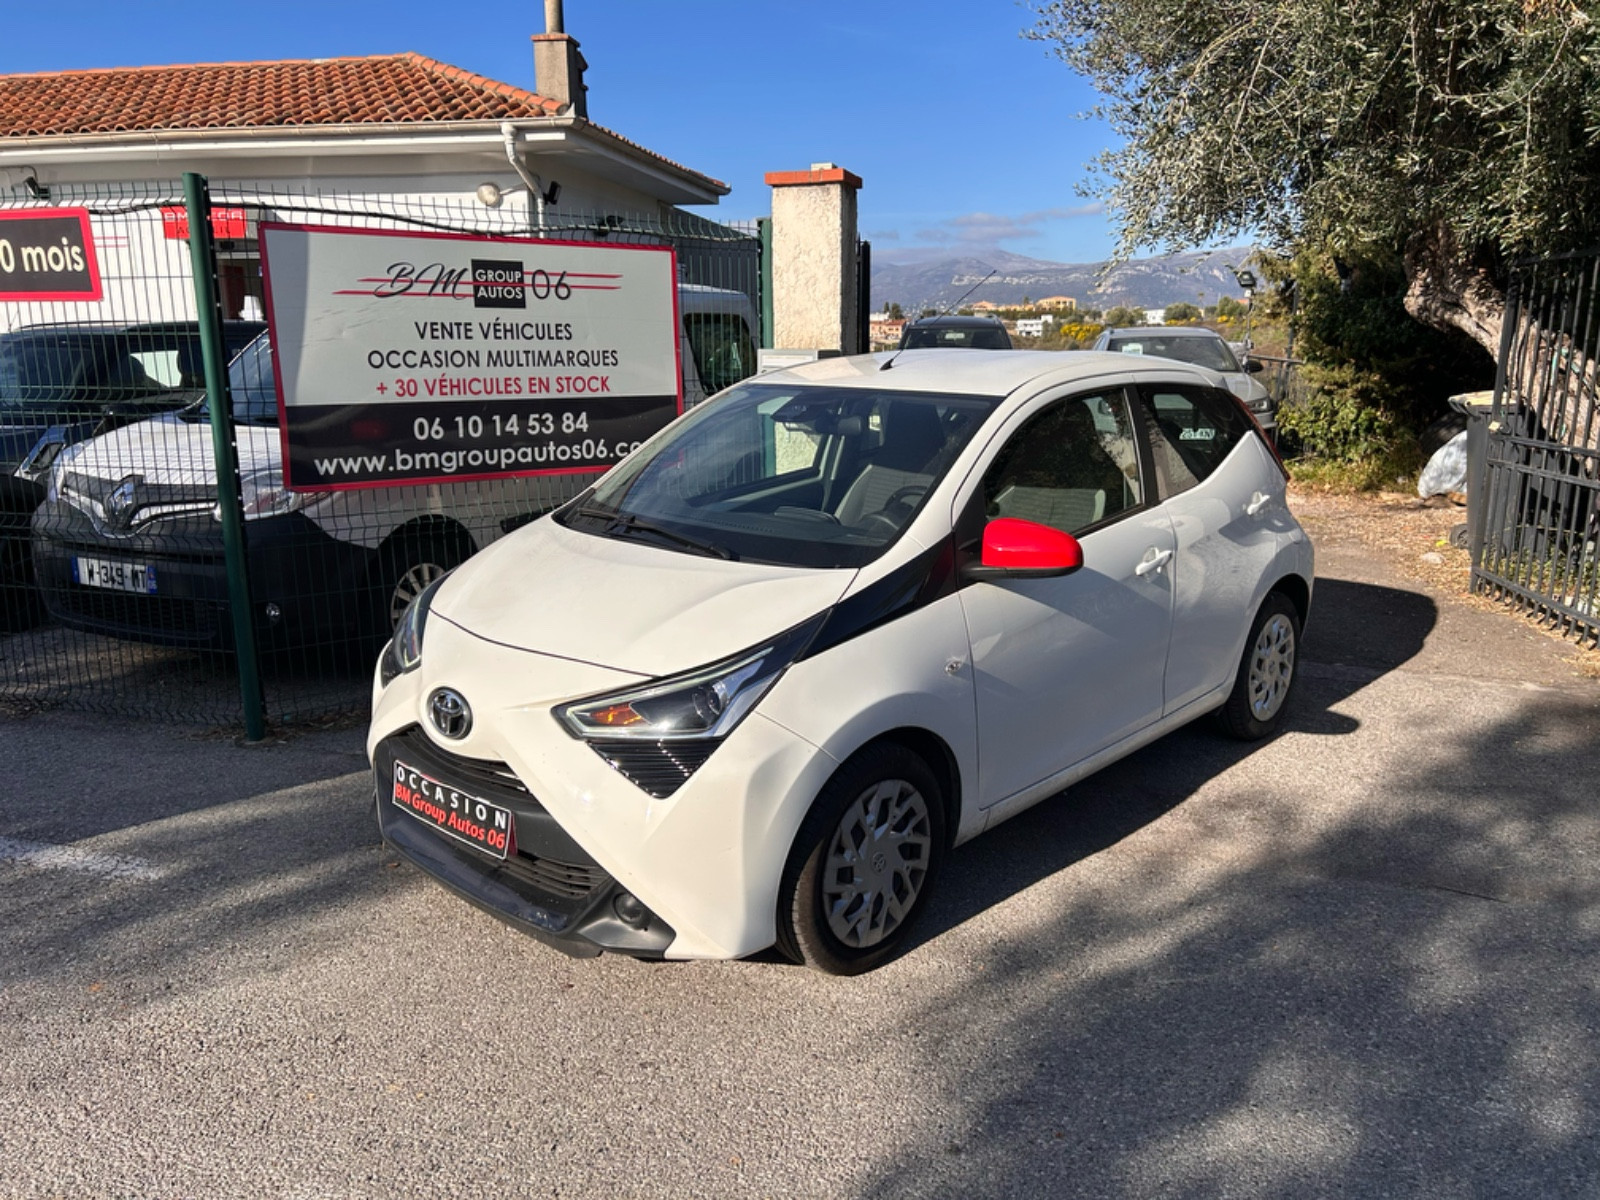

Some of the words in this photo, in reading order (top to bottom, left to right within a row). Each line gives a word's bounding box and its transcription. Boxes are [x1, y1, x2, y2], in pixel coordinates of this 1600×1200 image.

[21, 236, 84, 272] mois
[373, 262, 470, 300] BM
[475, 269, 522, 283] GROUP
[531, 269, 572, 300] 06
[477, 286, 523, 299] AUTOS
[414, 321, 473, 340] VENTE
[478, 317, 573, 341] VÉHICULES
[367, 350, 480, 369] OCCASION
[486, 350, 619, 368] MULTIMARQUES
[376, 382, 388, 395] +
[395, 378, 418, 397] 30
[423, 373, 522, 396] VÉHICULES
[528, 377, 550, 394] EN
[556, 376, 610, 393] STOCK
[413, 417, 444, 440] 06
[455, 415, 483, 438] 10
[492, 414, 519, 436] 14
[527, 412, 555, 434] 53
[562, 411, 589, 433] 84
[397, 766, 507, 829] OCCASION
[396, 783, 411, 805] BM
[412, 793, 446, 824] Group
[448, 812, 485, 841] Autos
[487, 829, 505, 849] 06
